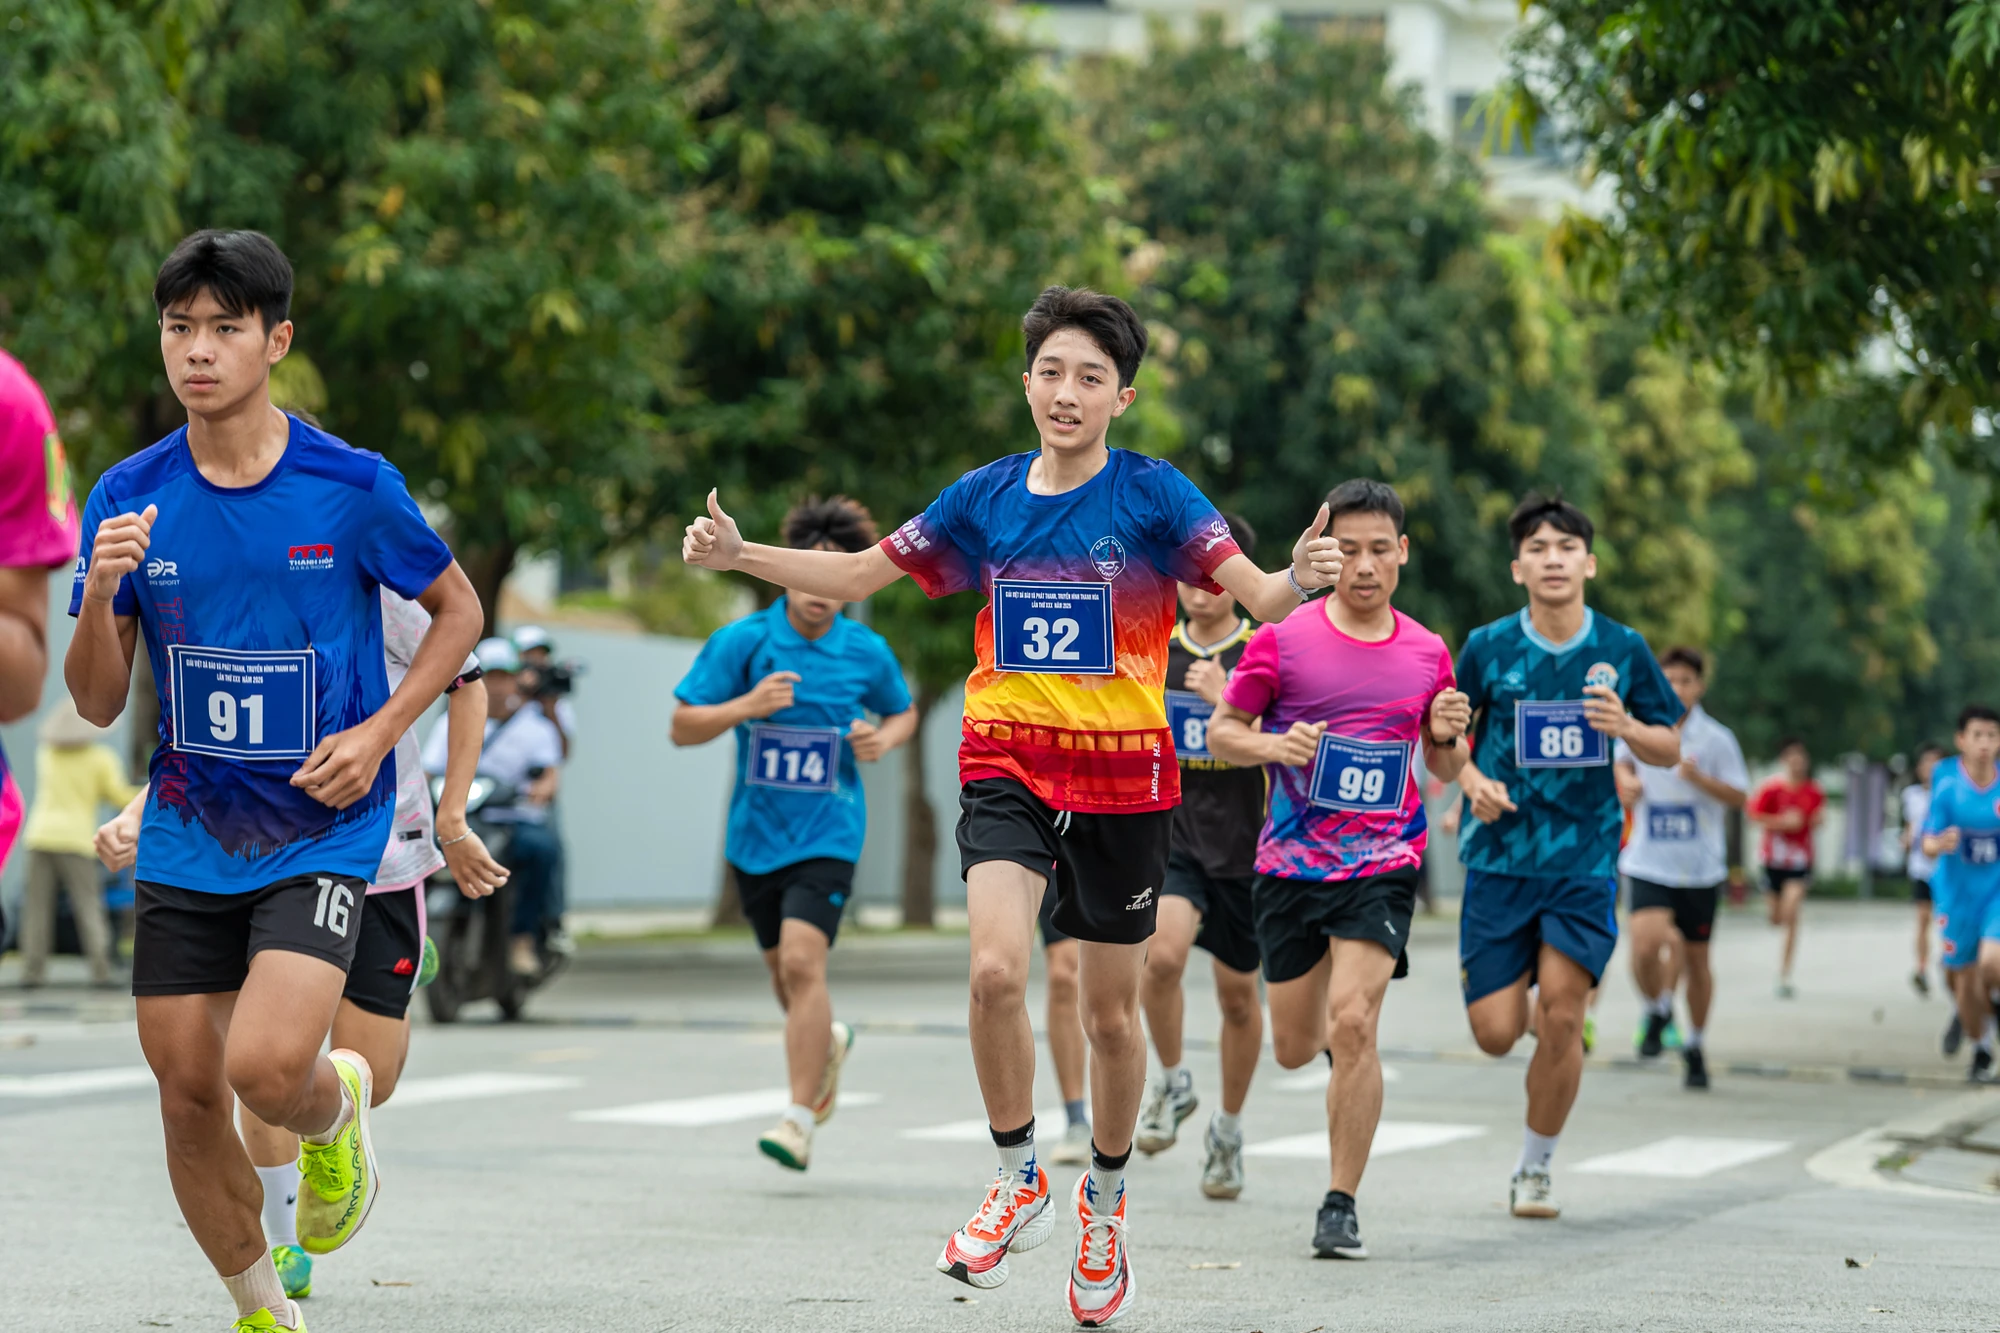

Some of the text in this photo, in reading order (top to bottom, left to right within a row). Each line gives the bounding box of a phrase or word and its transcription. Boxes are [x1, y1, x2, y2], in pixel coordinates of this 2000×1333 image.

[158, 579, 180, 587] SPORT
[1023, 617, 1080, 660] 32
[208, 690, 263, 744] 91
[1183, 717, 1209, 750] 8
[1540, 725, 1584, 758] 86
[762, 747, 825, 783] 114
[1151, 762, 1160, 801] SPORT
[1338, 766, 1385, 803] 99
